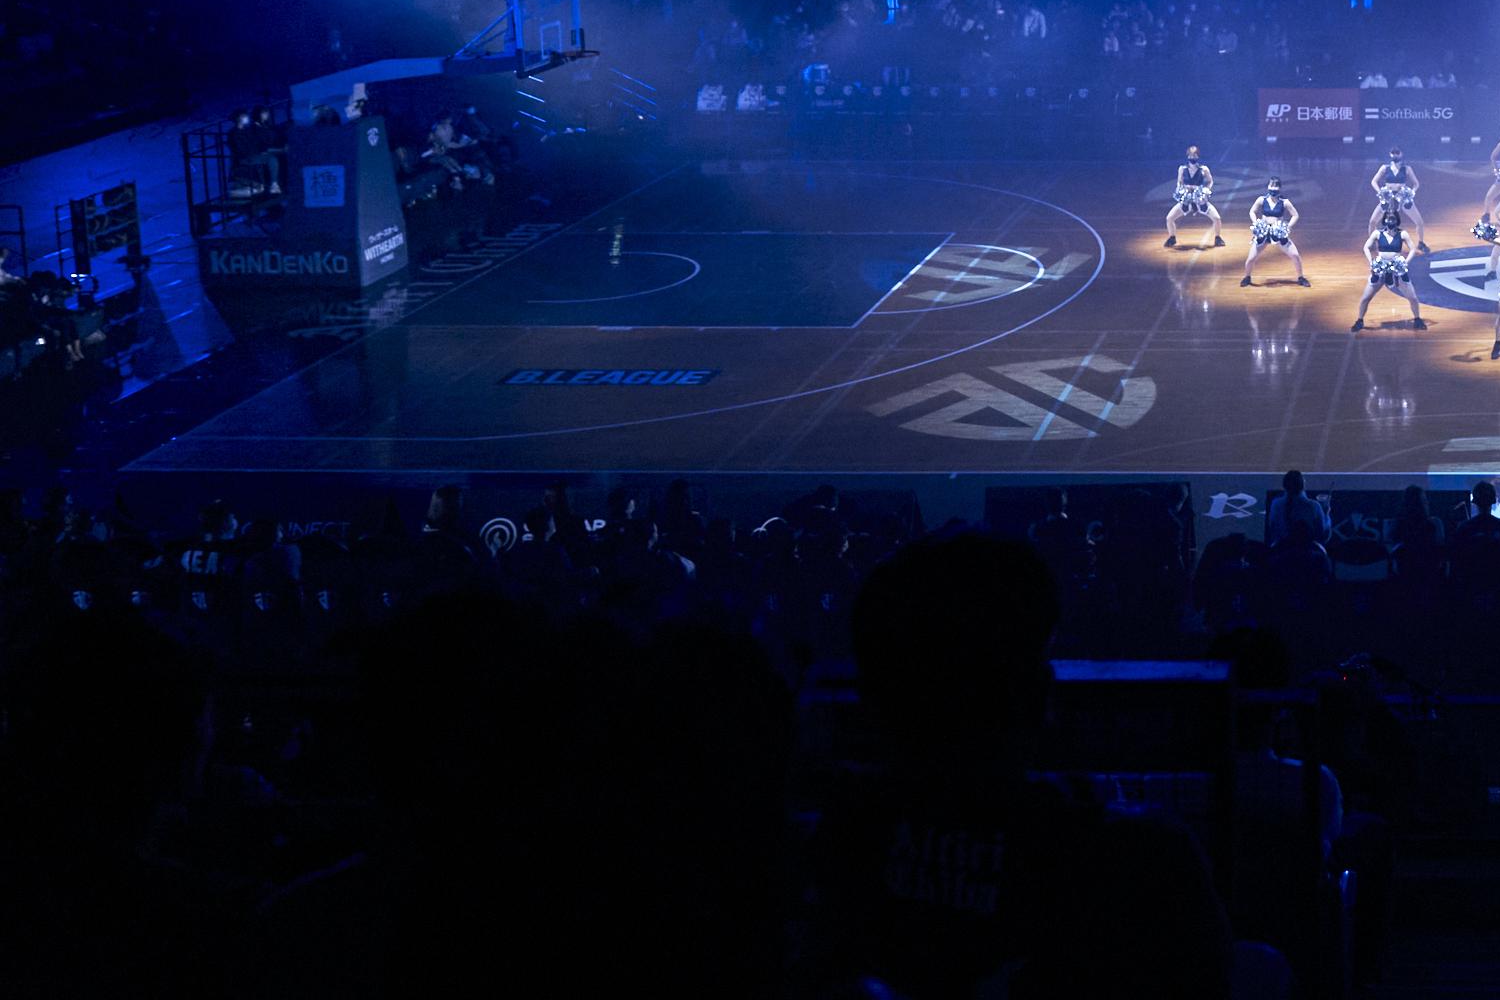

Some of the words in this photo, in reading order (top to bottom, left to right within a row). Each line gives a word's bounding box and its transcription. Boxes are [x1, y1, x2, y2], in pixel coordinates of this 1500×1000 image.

[1266, 104, 1291, 117] JP
[1297, 107, 1353, 121] 日本郵便
[1381, 108, 1431, 119] SoftBank
[1432, 107, 1454, 119] 5G
[506, 370, 711, 384] B.LEAGUE
